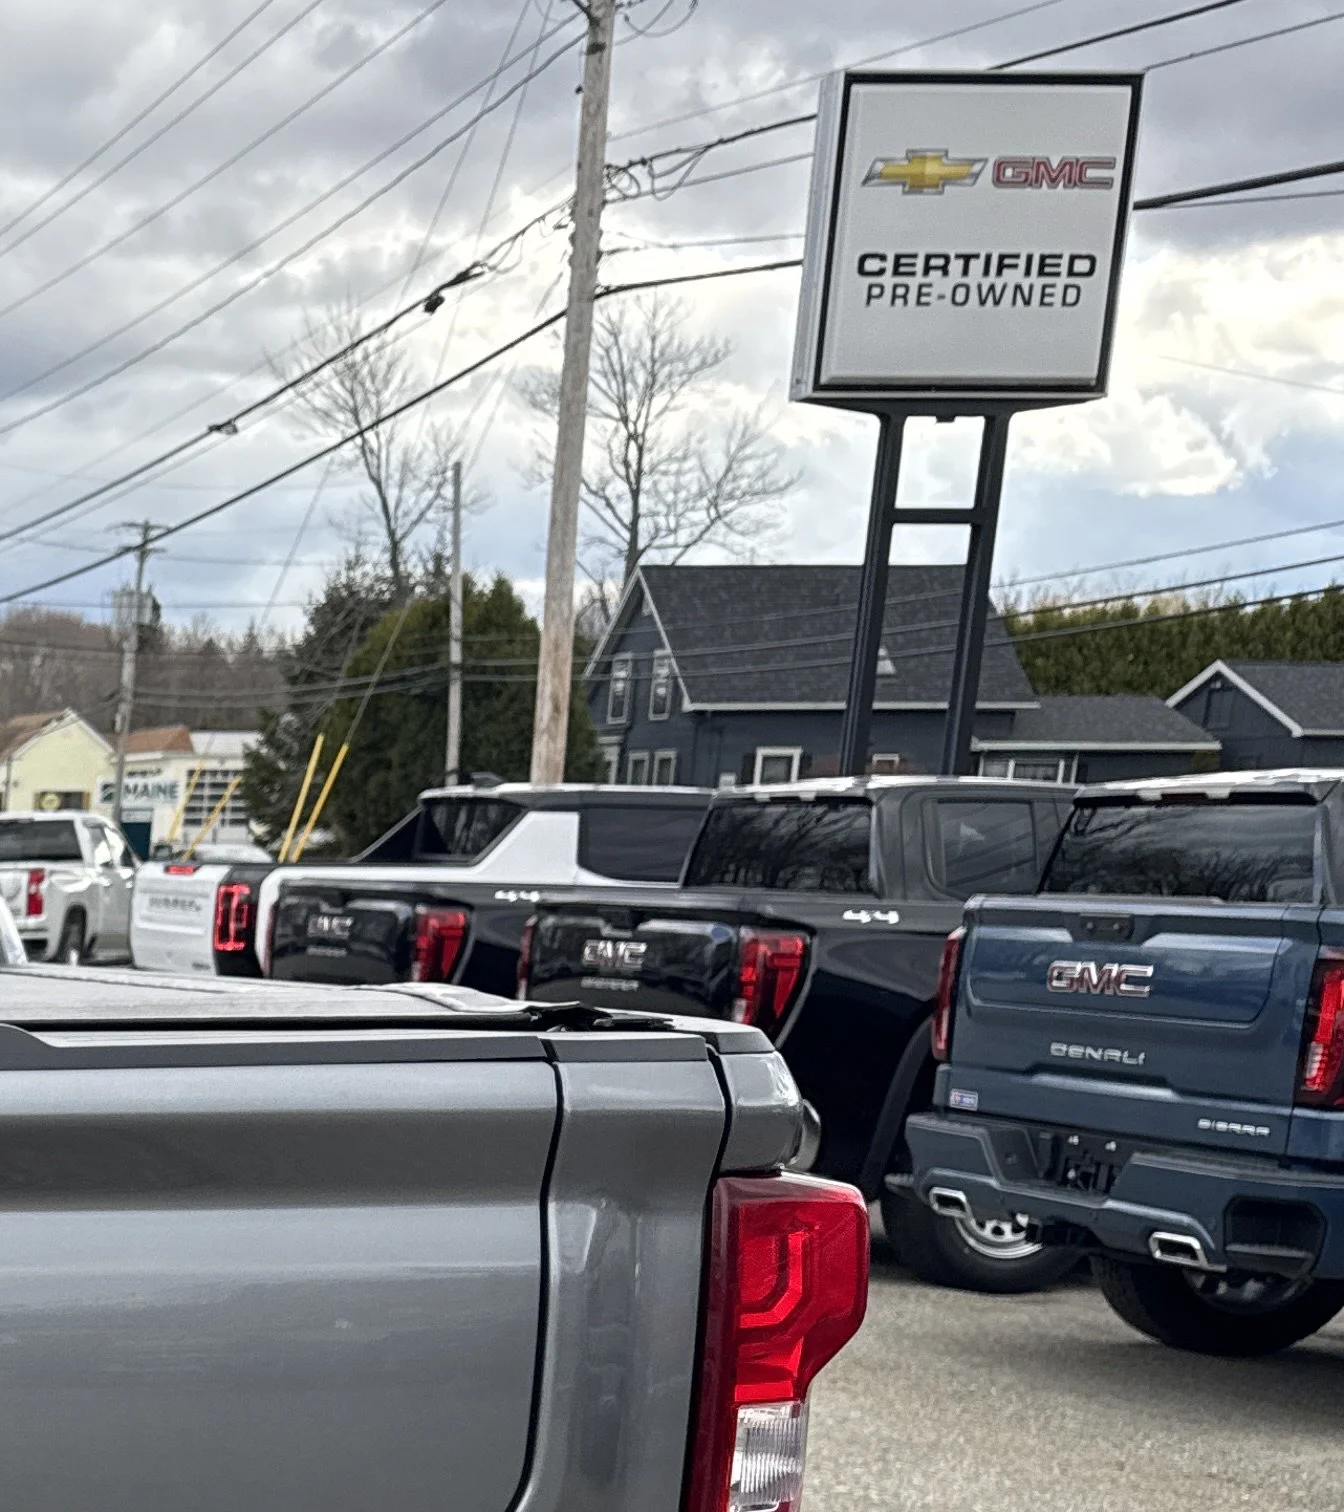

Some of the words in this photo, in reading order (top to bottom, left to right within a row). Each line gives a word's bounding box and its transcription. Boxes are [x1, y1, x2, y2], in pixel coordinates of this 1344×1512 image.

[992, 155, 1116, 190] GMC
[857, 252, 1097, 279] CERTIFIED
[865, 282, 1082, 307] PRE-OWNED
[124, 781, 179, 800] MAINE
[1046, 959, 1155, 999] GMC
[1049, 1041, 1146, 1066] DENALI
[1197, 1118, 1271, 1138] SIERRA
